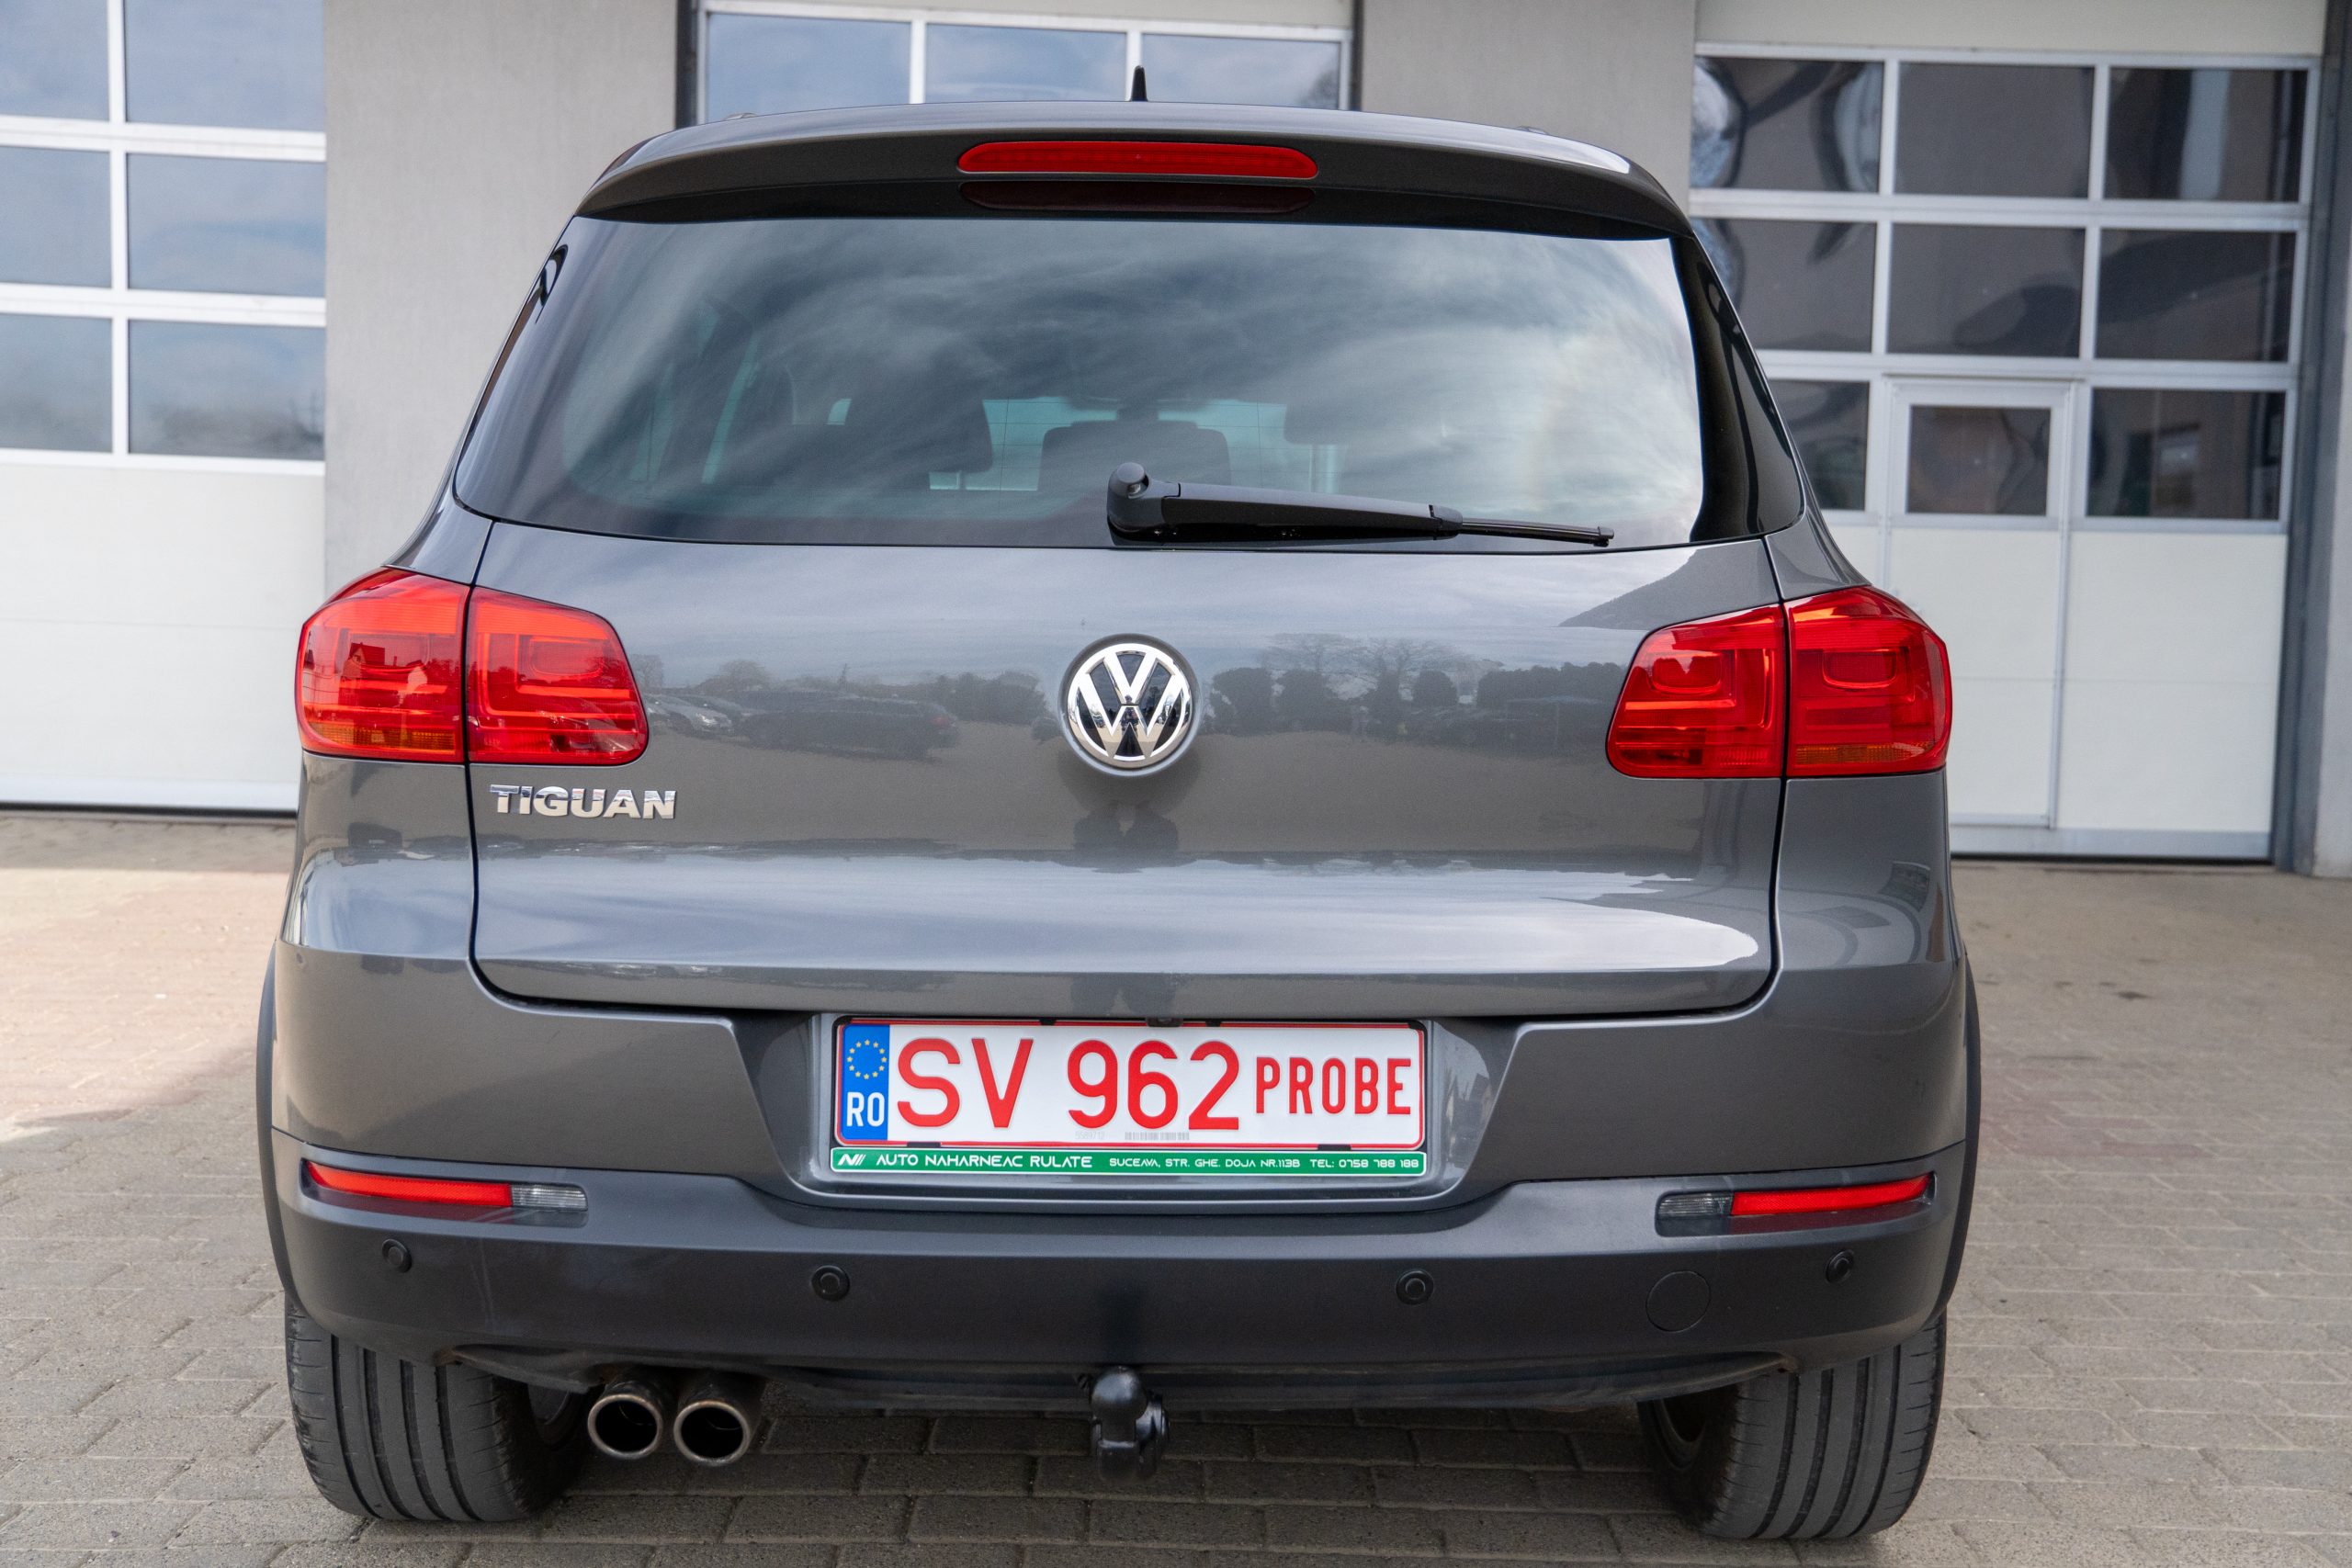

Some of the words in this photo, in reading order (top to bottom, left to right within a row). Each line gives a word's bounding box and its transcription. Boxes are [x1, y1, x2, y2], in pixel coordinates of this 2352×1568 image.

[490, 784, 676, 819] TIGUAN
[897, 1038, 1035, 1129] SV
[1067, 1039, 1240, 1131] 962
[1255, 1056, 1412, 1115] PROBE
[846, 1091, 885, 1128] RO
[876, 1154, 919, 1167] AUTO
[924, 1155, 1023, 1168] NAHARNEAC
[1029, 1156, 1092, 1168] RULATE
[1109, 1157, 1161, 1168] SUCEAVA,
[1165, 1158, 1191, 1168] STR.
[1194, 1158, 1221, 1168] GHE.
[1225, 1159, 1256, 1168] DOJA
[1310, 1159, 1334, 1168] TEL:
[1339, 1159, 1369, 1168] 0758
[1374, 1159, 1396, 1168] 788
[1399, 1159, 1419, 1168] 188
